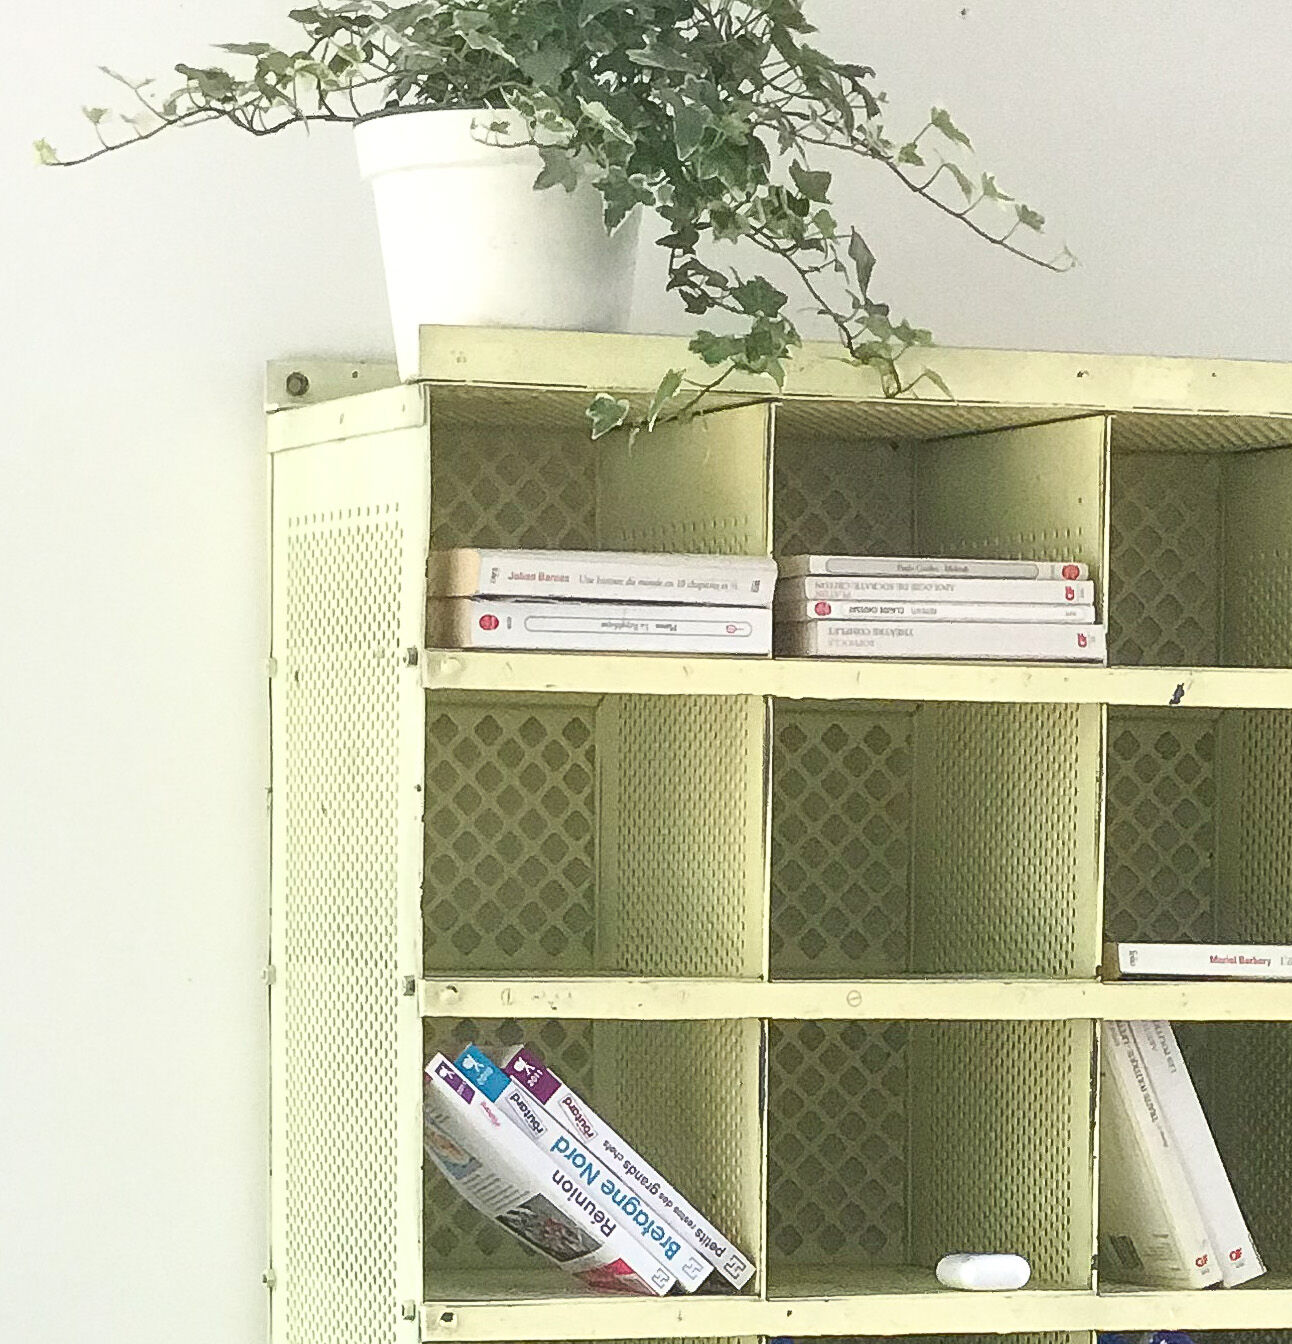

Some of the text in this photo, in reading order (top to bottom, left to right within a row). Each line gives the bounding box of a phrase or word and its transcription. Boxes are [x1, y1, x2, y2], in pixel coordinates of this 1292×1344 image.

[549, 1135, 681, 1260] Bretagne Nord
[551, 1169, 616, 1237] Réunion
[622, 1159, 660, 1195] grands
[694, 1227, 726, 1257] petits
